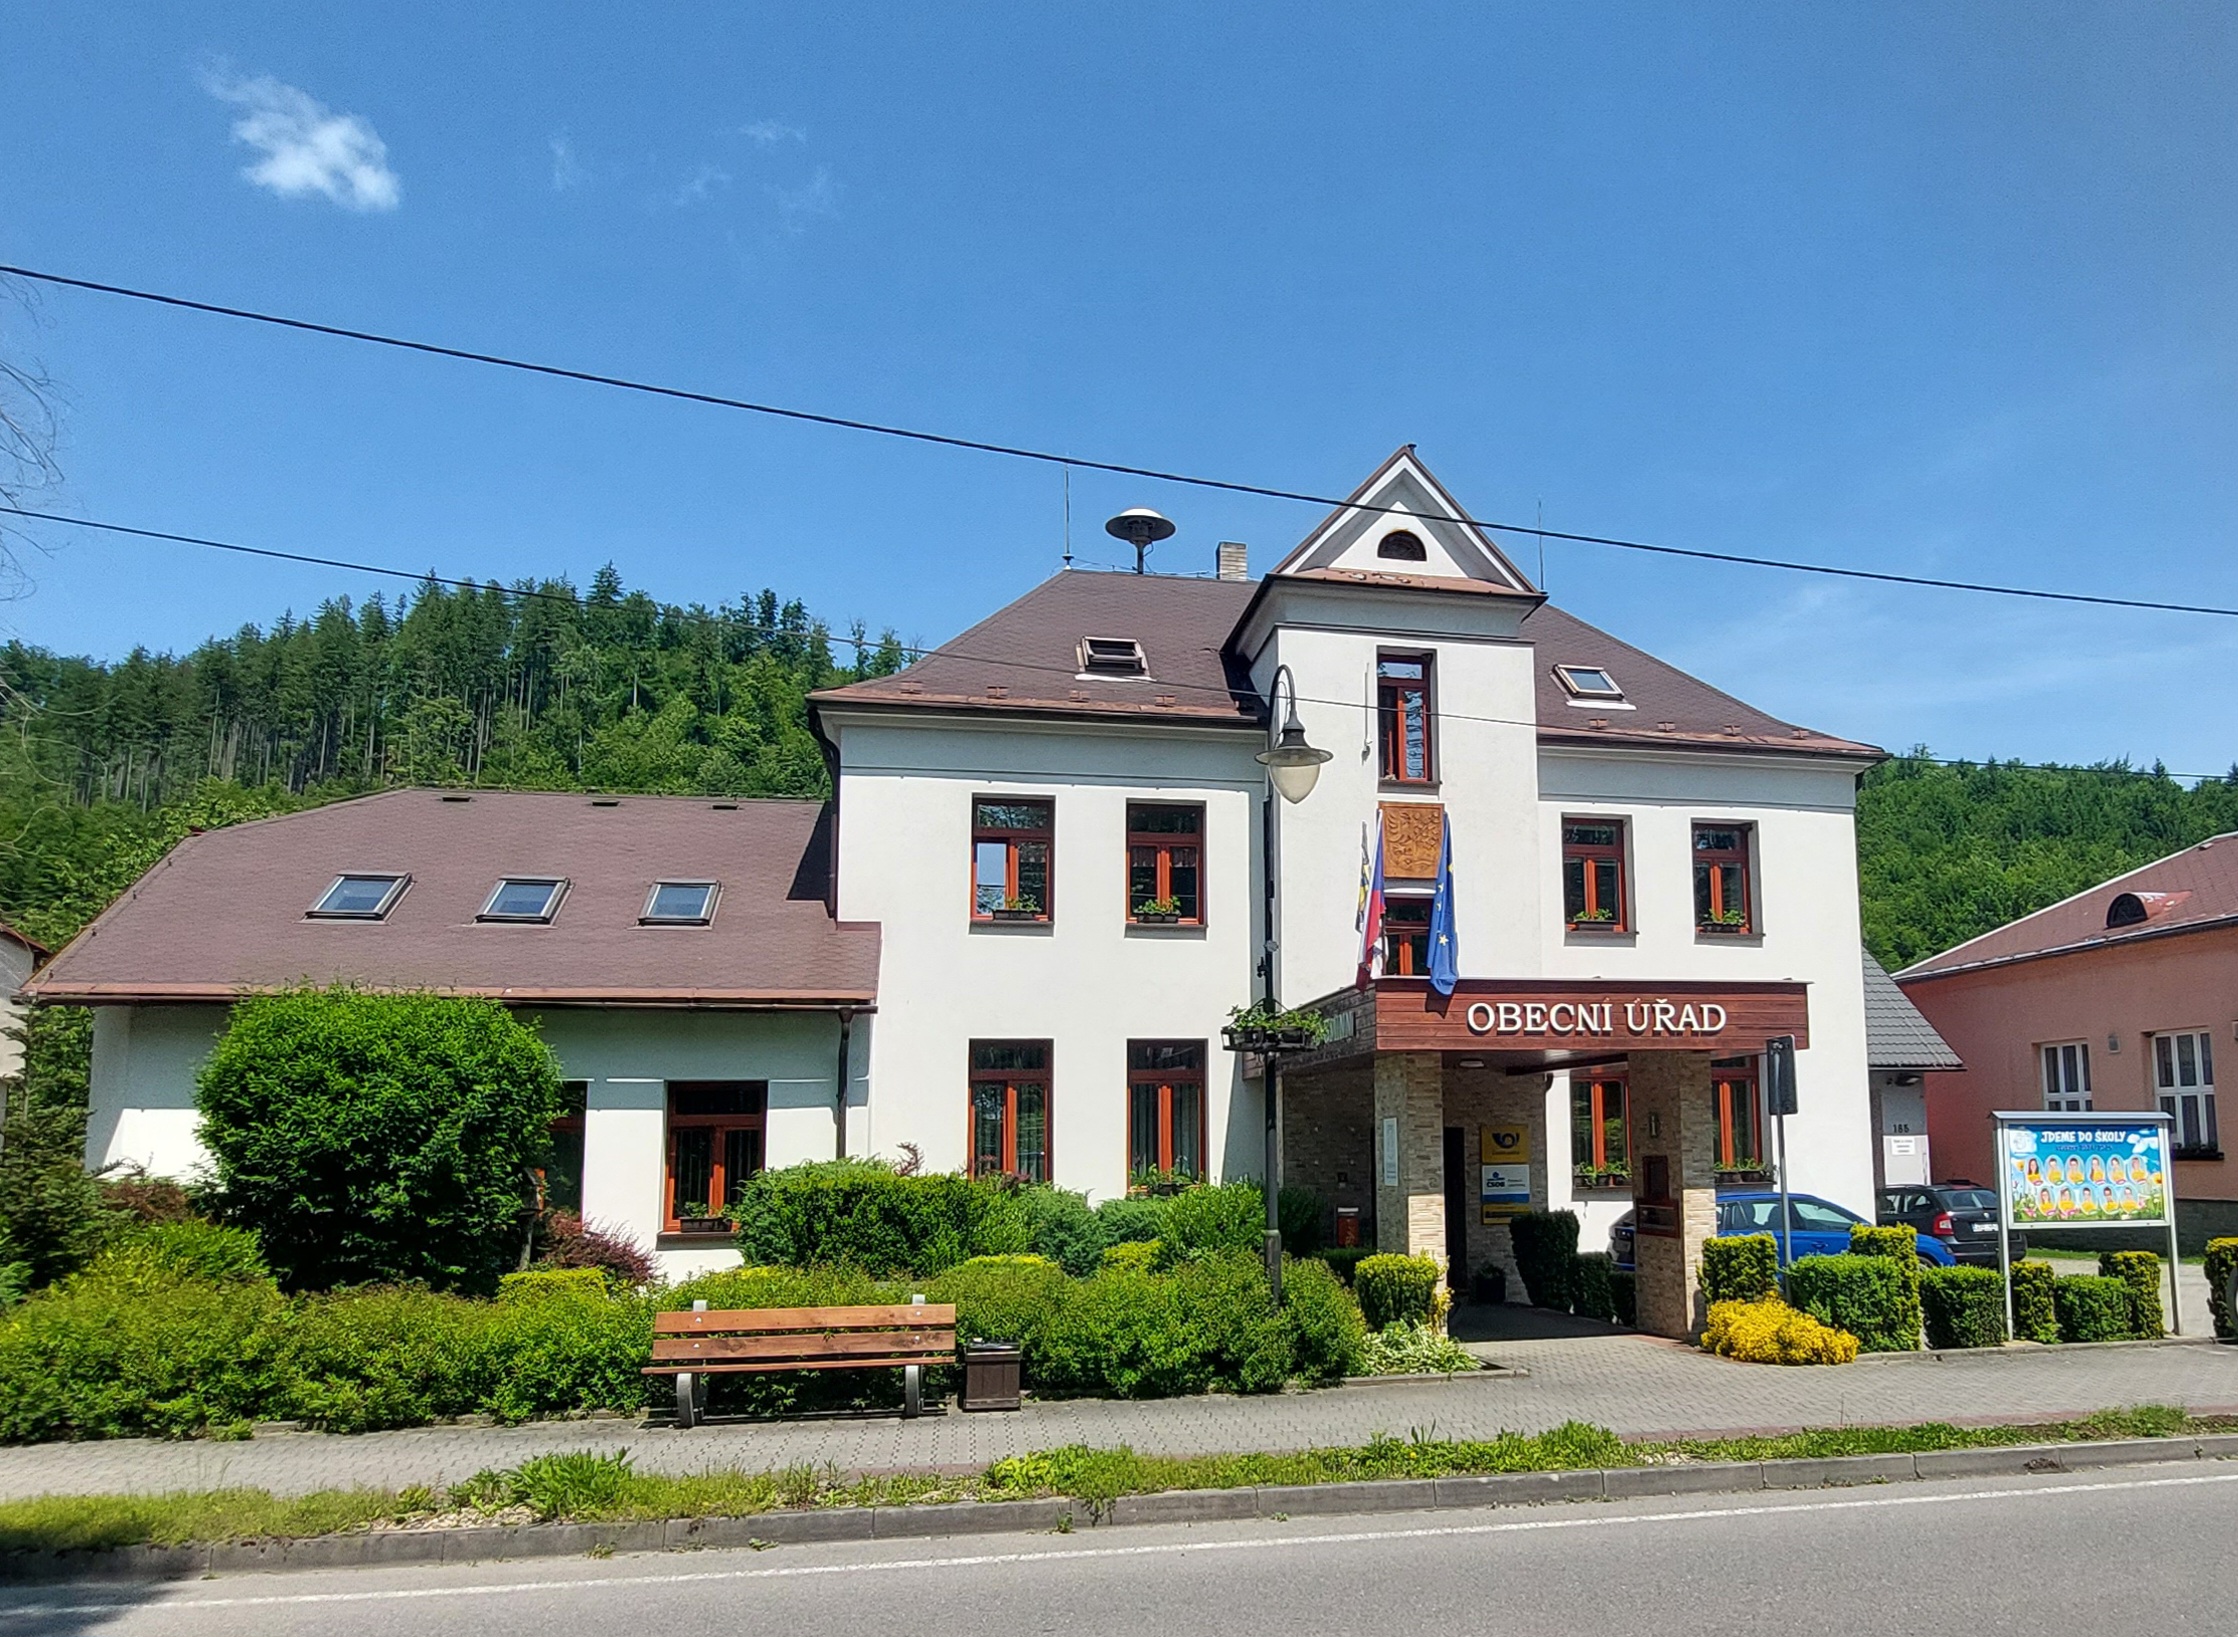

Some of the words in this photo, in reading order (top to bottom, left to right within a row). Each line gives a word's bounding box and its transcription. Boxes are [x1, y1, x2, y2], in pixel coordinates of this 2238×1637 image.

[1467, 997, 1614, 1033] OBECNÍ
[1624, 997, 1727, 1033] ÚŘAD
[2041, 1131, 2076, 1143] JDEME
[2077, 1131, 2093, 1143] DO
[2094, 1129, 2126, 1143] ŠKOLY
